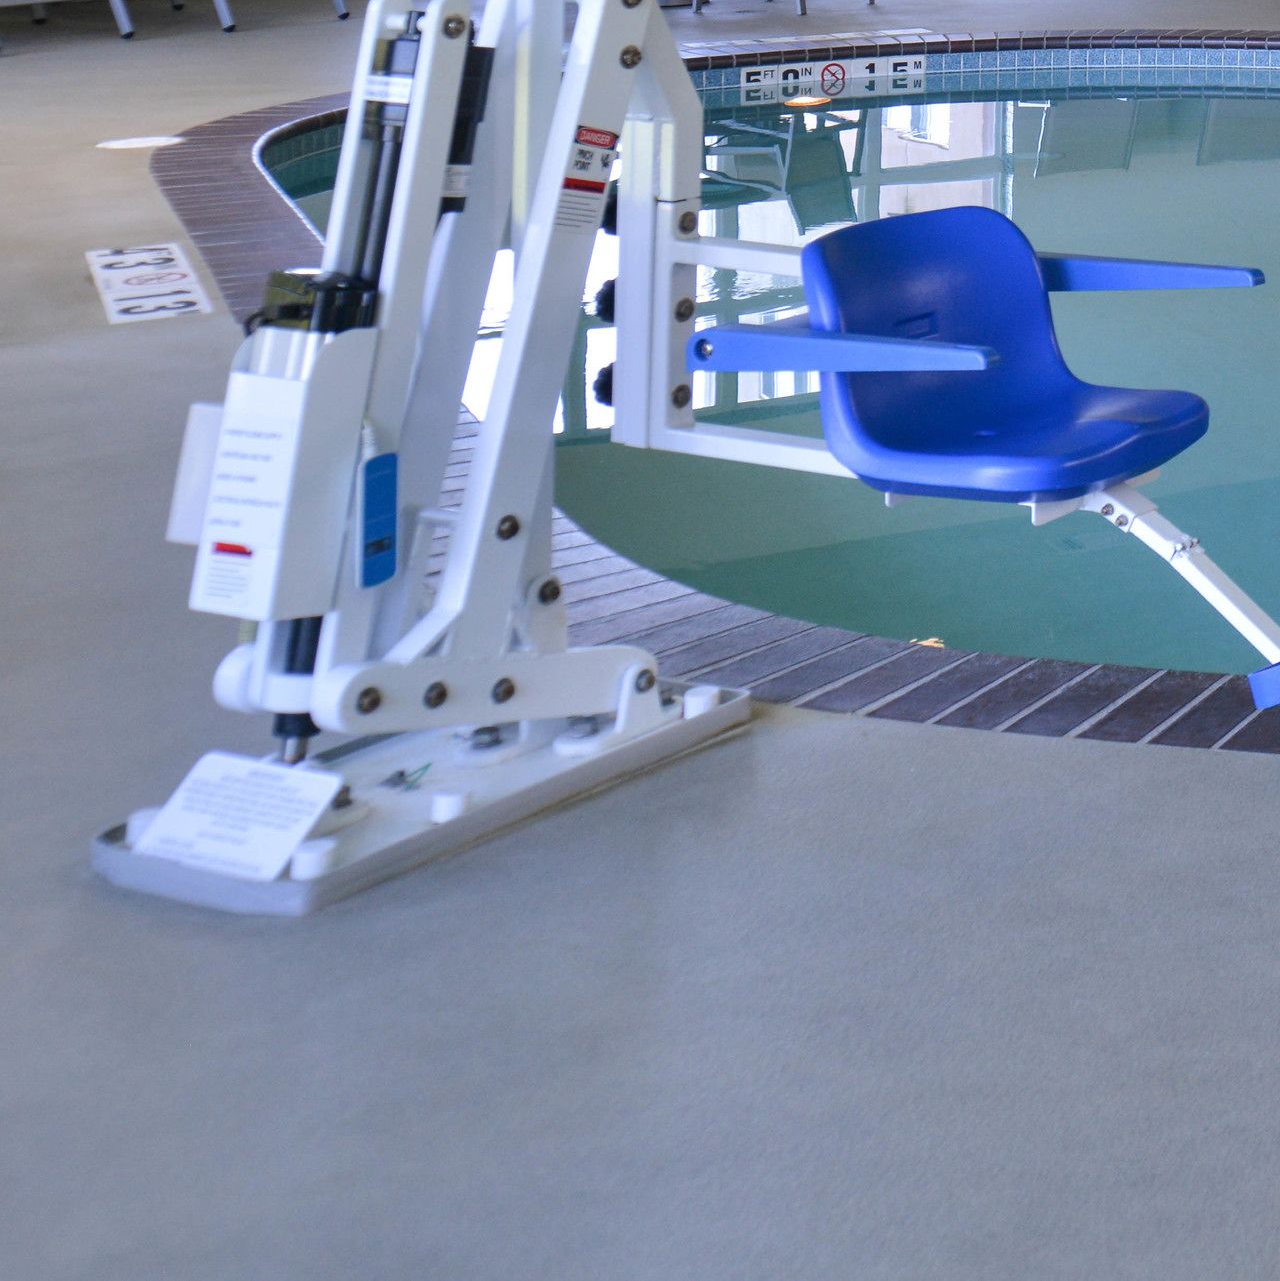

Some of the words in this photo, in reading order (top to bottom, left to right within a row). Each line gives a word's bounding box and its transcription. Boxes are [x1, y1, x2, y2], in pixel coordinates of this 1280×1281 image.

[763, 69, 775, 79] FT
[801, 67, 812, 77] IN
[913, 61, 922, 69] M
[580, 130, 611, 145] DANGER
[100, 257, 175, 270] 3
